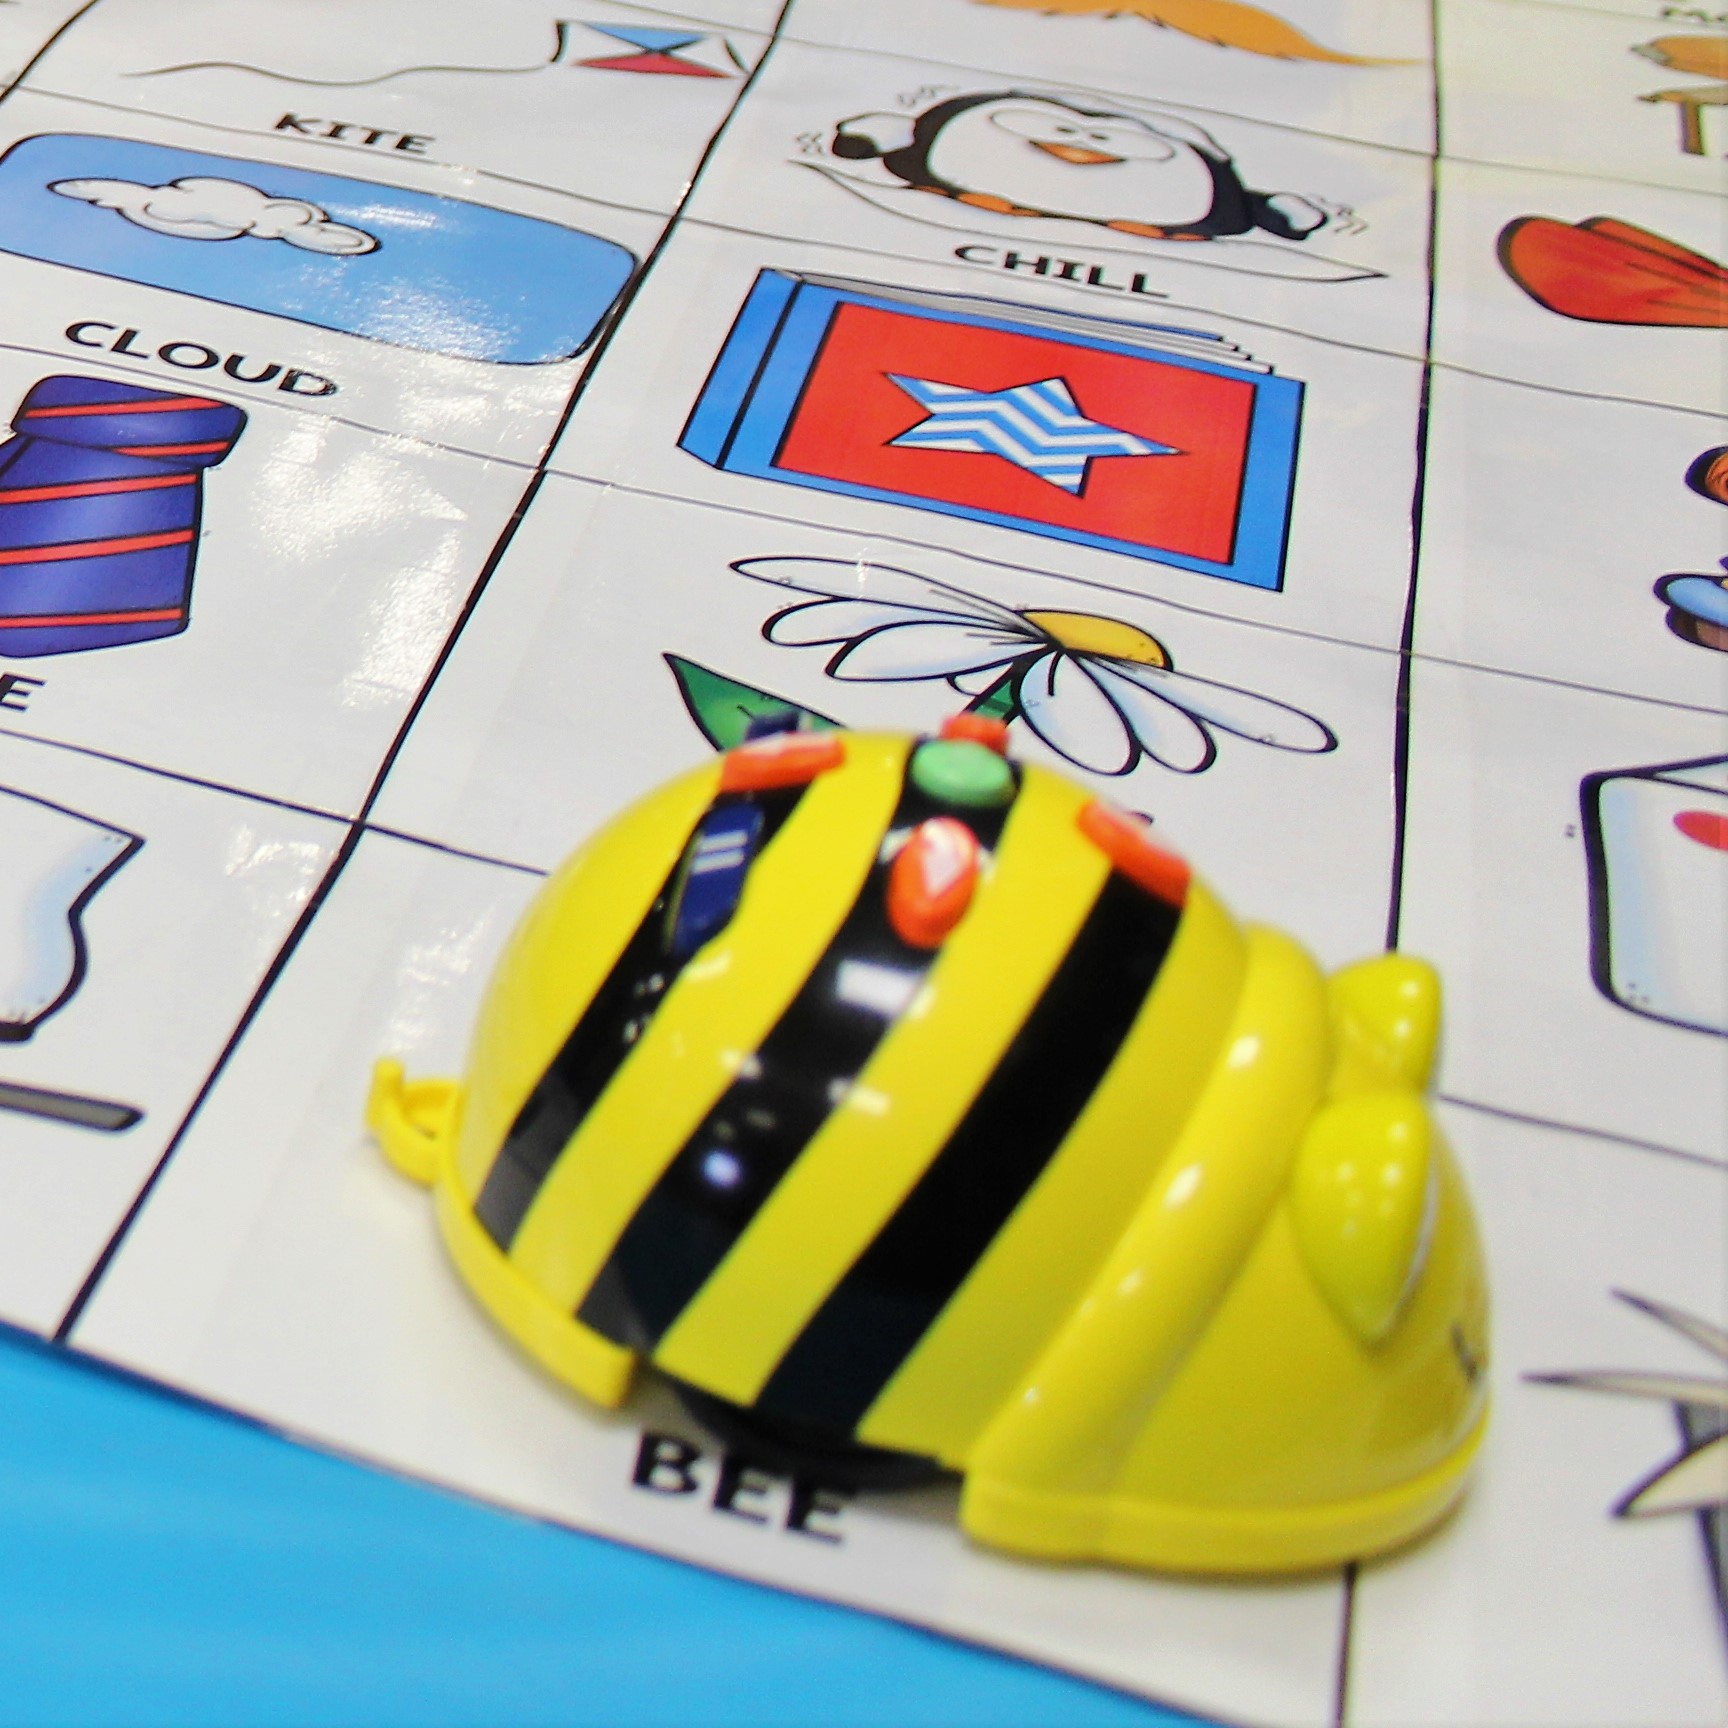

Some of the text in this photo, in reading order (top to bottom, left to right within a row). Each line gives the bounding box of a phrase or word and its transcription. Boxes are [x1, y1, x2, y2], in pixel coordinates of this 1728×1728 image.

[274, 112, 437, 155] KITE
[953, 244, 1170, 299] CHILL
[64, 321, 339, 397] CLOUD
[631, 1432, 851, 1546] BEE
